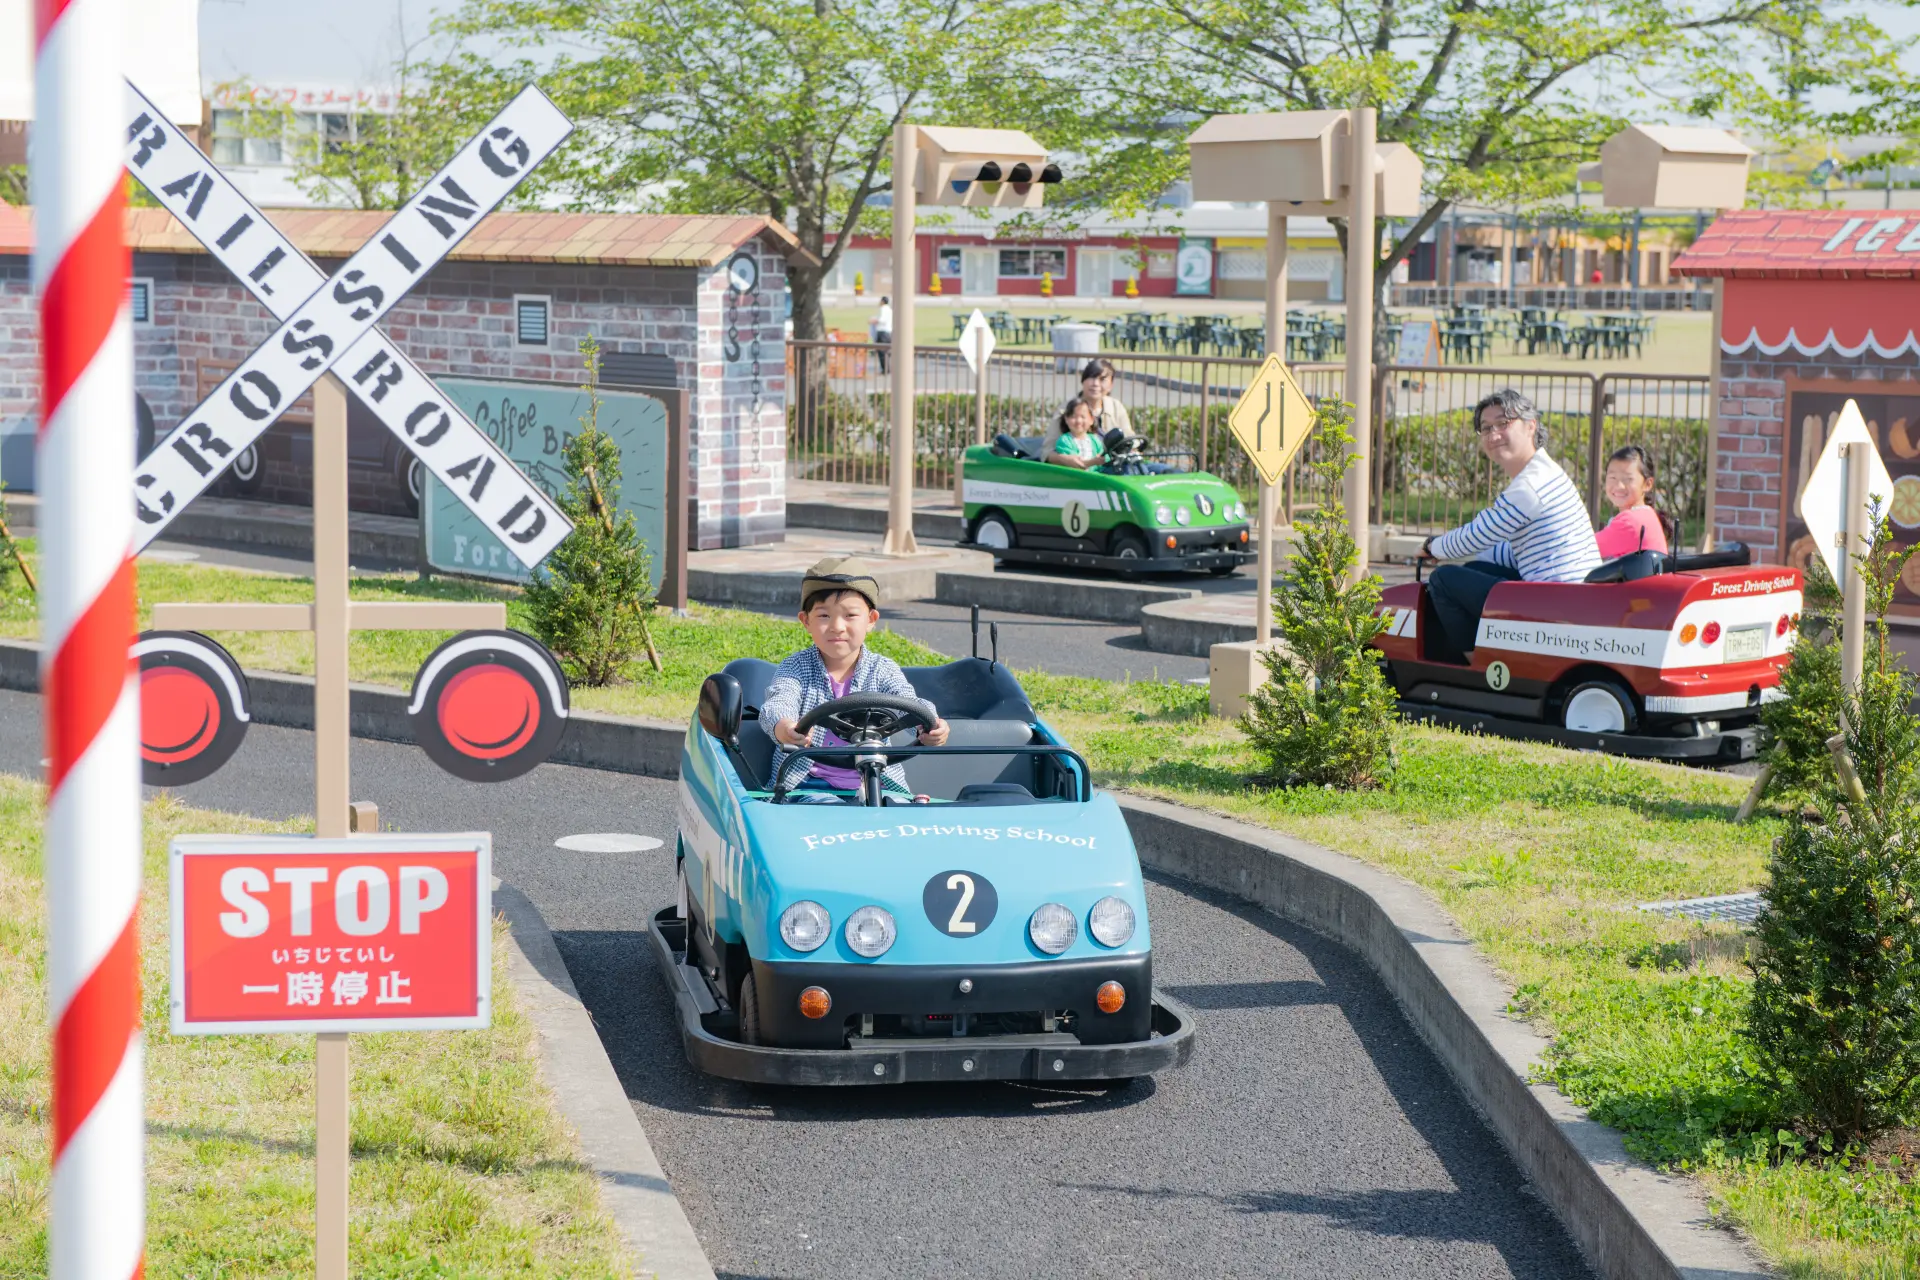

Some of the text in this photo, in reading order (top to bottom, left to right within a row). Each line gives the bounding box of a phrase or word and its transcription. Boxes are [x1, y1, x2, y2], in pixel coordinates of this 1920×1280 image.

[249, 87, 402, 108] インフォメーショ
[127, 112, 547, 544] RAIL ROAD
[135, 126, 530, 524] CROSSING
[475, 397, 537, 453] Coffee
[1070, 502, 1081, 533] 6
[1199, 493, 1212, 516] 6
[453, 533, 534, 573] Fore
[1711, 574, 1796, 596] Forest Driving School
[1485, 624, 1646, 656] Forest Driving School
[1492, 664, 1503, 689] 3
[800, 824, 1098, 851] Forest Driving School
[219, 865, 449, 938] STOP
[946, 873, 976, 933] 2
[272, 946, 395, 965] いちじていし
[242, 970, 412, 1006] 一時停止
